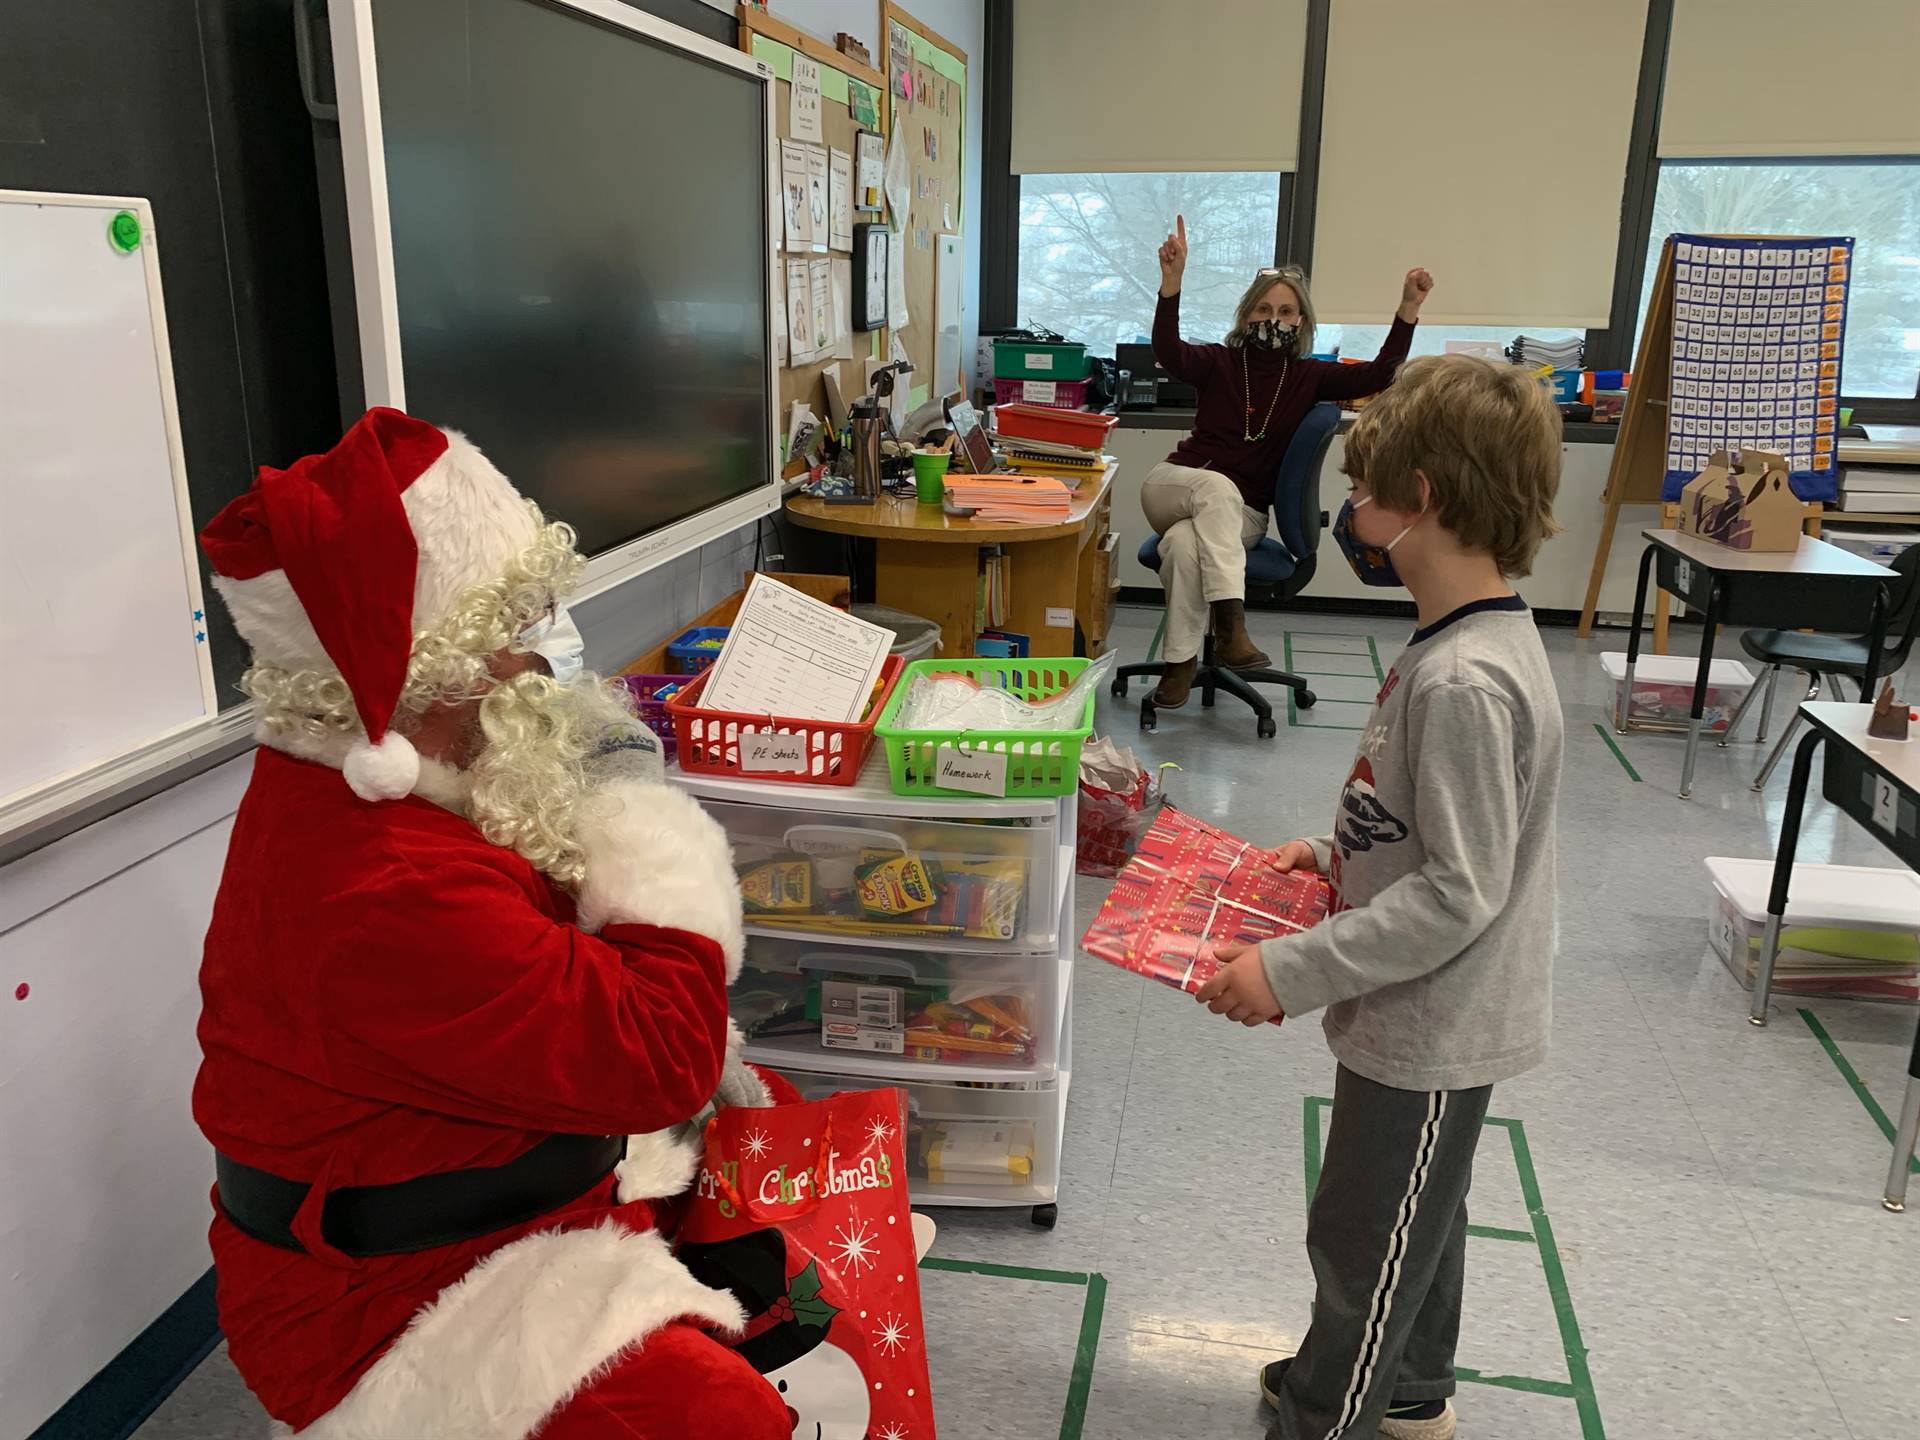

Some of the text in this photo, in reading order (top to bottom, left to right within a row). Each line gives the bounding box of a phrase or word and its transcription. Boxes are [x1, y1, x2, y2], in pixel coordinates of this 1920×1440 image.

[1694, 270, 1702, 278] 12
[1711, 272, 1719, 280] 13
[1746, 273, 1753, 281] 15
[1812, 271, 1821, 279] 19
[1680, 287, 1687, 295] 21
[1693, 289, 1703, 298] 22
[1708, 291, 1719, 299] 23
[1726, 292, 1735, 300] 24
[1742, 292, 1752, 300] 25
[1758, 293, 1768, 301] 26
[1774, 293, 1784, 301] 27
[1791, 292, 1800, 300] 28
[1808, 291, 1820, 299] 29
[1692, 309, 1701, 317] 32
[1706, 310, 1716, 318] 33
[1723, 311, 1733, 319] 34
[1788, 311, 1798, 319] 38
[1806, 310, 1818, 318] 39
[1737, 331, 1746, 339] 45
[1769, 330, 1779, 338] 47
[1786, 329, 1796, 337] 48
[1690, 346, 1698, 354] 52
[1704, 348, 1713, 356] 53
[1735, 349, 1744, 357] 55
[1767, 349, 1777, 357] 57
[1784, 349, 1794, 357] 58
[1804, 347, 1815, 356] 59
[1689, 366, 1697, 374] 62
[1702, 367, 1711, 375] 63
[1748, 368, 1758, 376] 66
[1688, 384, 1695, 392] 72
[1763, 386, 1773, 394] 77
[1781, 386, 1791, 394] 78
[1801, 384, 1812, 392] 79
[1700, 404, 1708, 412] 83
[1730, 405, 1739, 413] 85
[1761, 405, 1772, 413] 87
[1799, 403, 1811, 411] 89
[1673, 420, 1680, 428] 91
[1686, 422, 1694, 430] 92
[1760, 423, 1770, 431] 97
[1699, 441, 1708, 450] 103
[1728, 442, 1739, 450] 105
[1758, 442, 1772, 450] 107
[752, 747, 768, 760] PE
[942, 761, 992, 780] Homework
[1882, 785, 1889, 808] 2
[910, 863, 927, 898] Crayola
[1724, 924, 1729, 942] 2
[831, 999, 838, 1008] 3
[697, 1160, 739, 1218] rry
